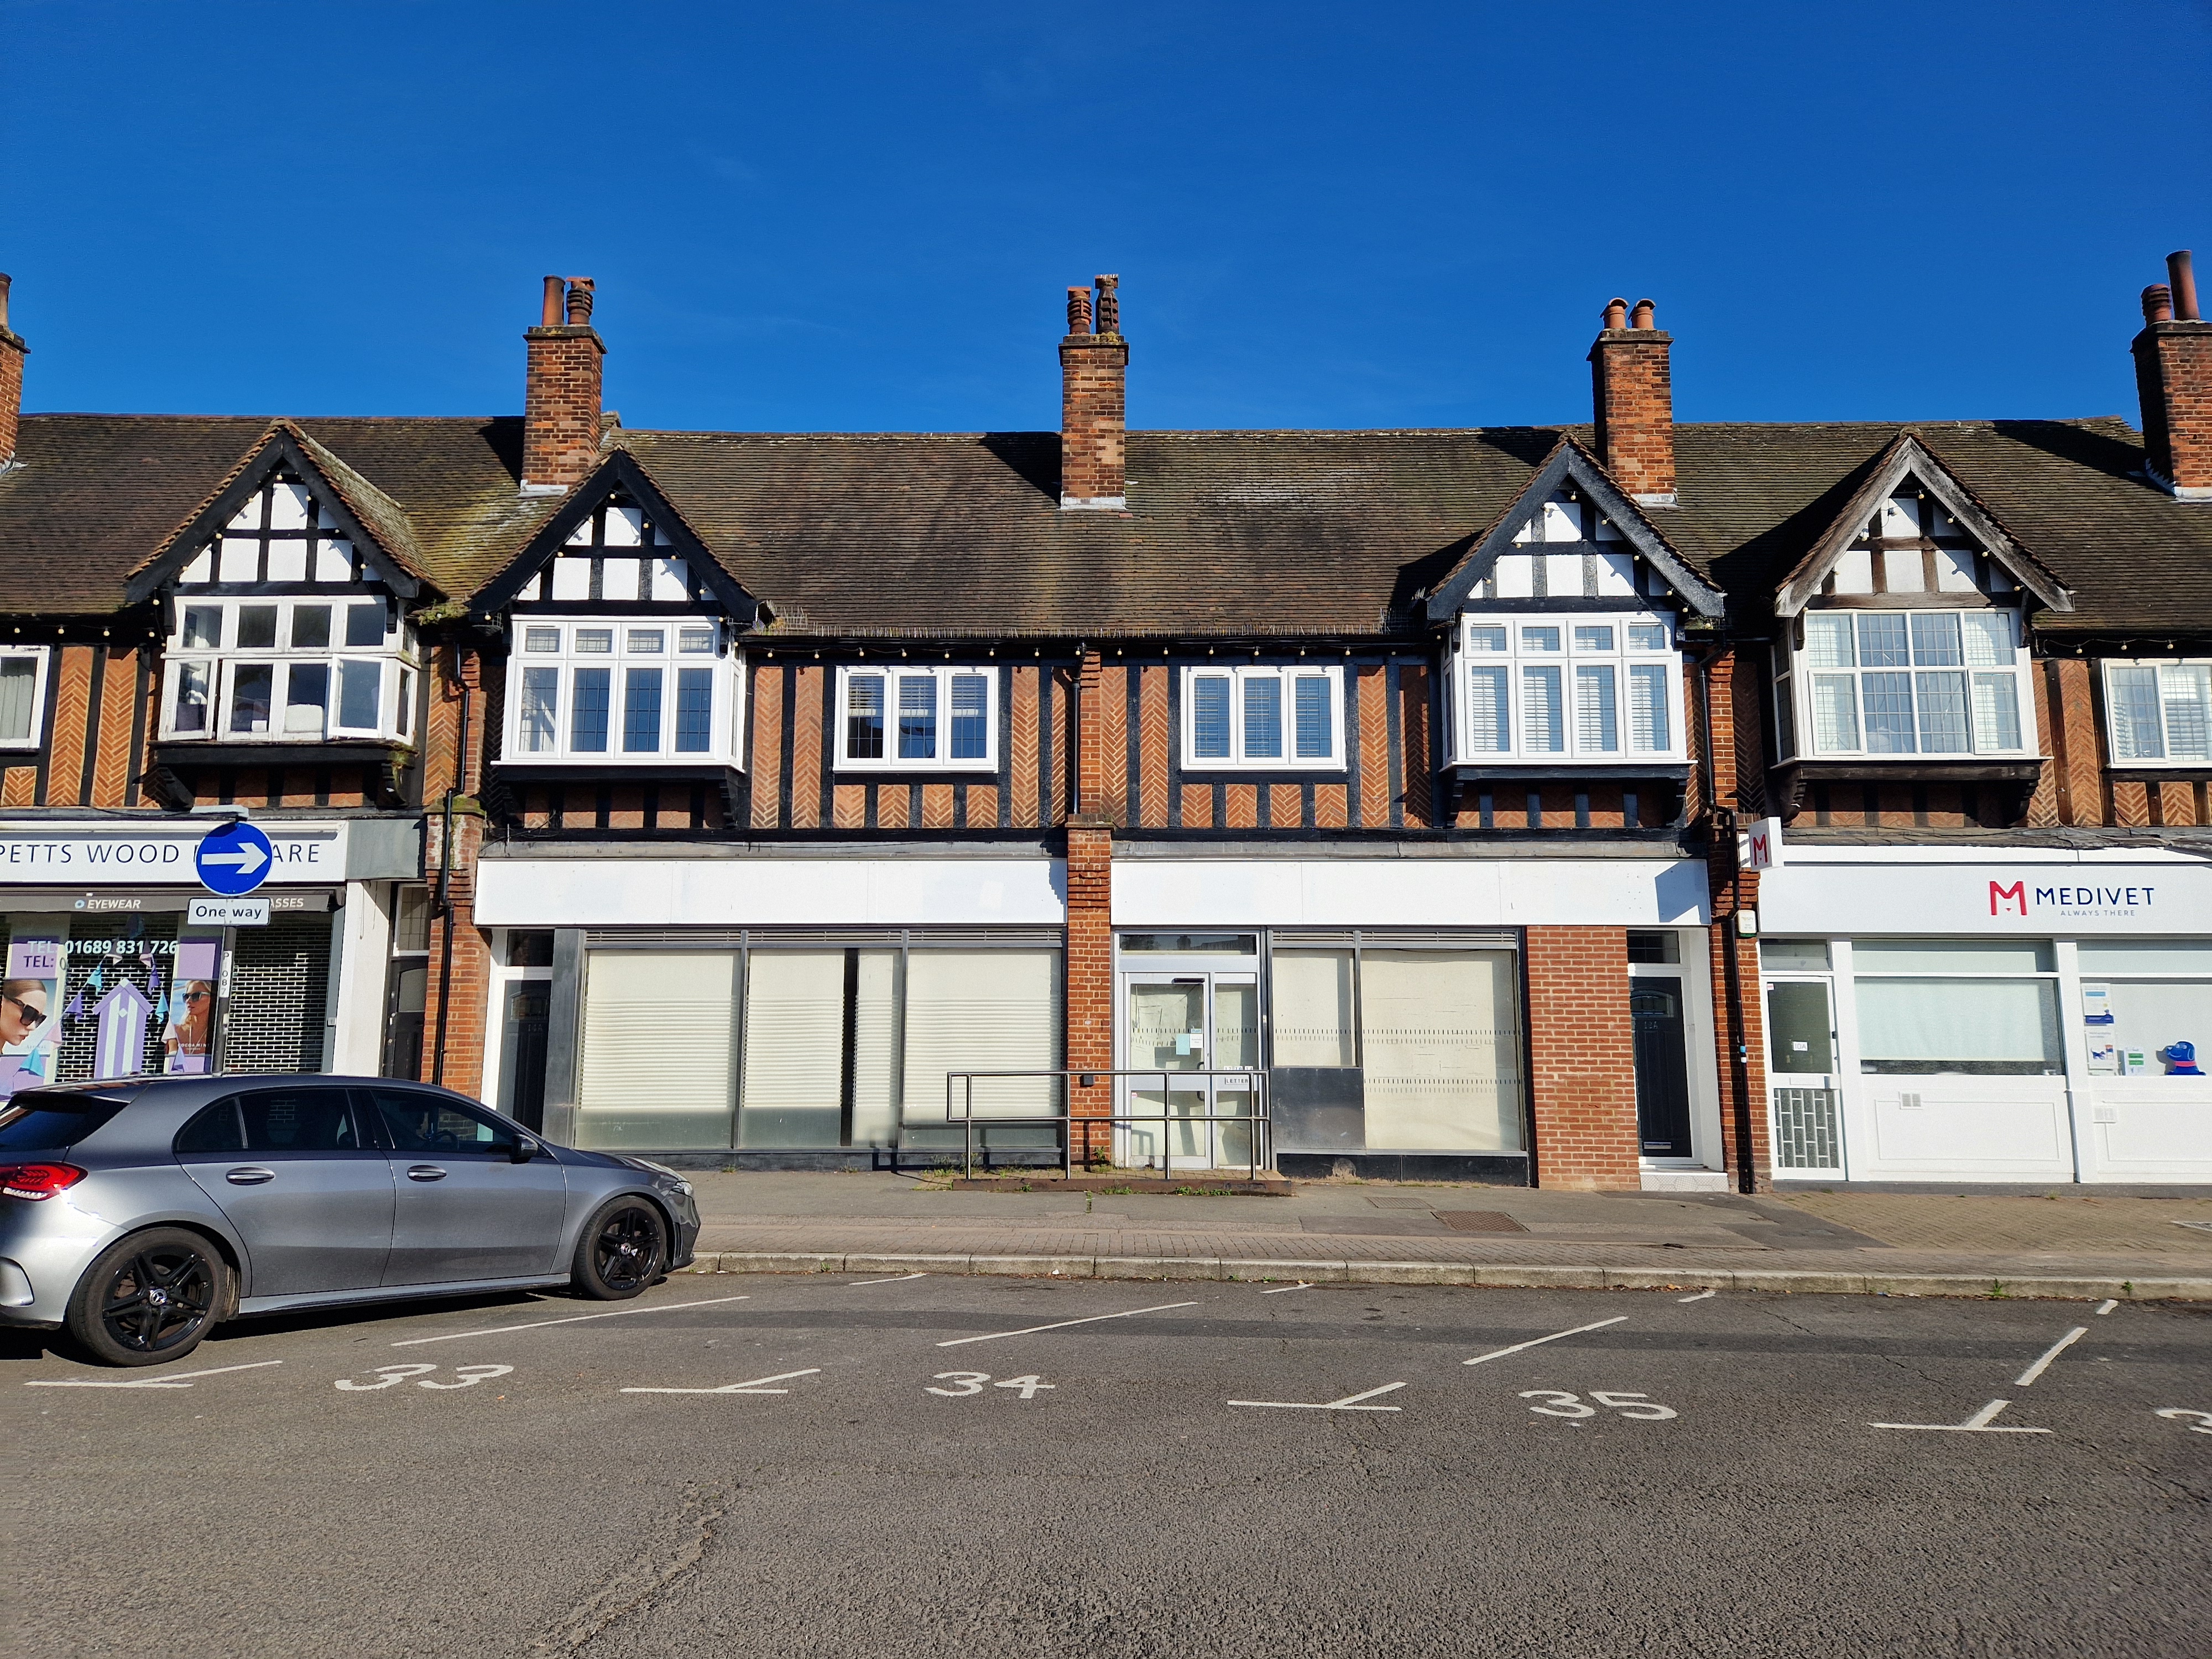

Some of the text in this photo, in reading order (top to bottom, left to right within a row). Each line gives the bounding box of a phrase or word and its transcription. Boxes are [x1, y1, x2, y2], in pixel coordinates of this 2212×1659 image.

[86, 844, 179, 863] WOOD
[87, 899, 141, 909] EYEWEAR
[2036, 888, 2154, 905] MEDIVET
[196, 906, 262, 919] One way
[65, 940, 112, 954] 01689
[116, 940, 144, 954] 831
[150, 940, 178, 954] 726
[334, 1363, 514, 1391] 33
[924, 1371, 1056, 1399] 34
[1518, 1390, 1677, 1420] 35
